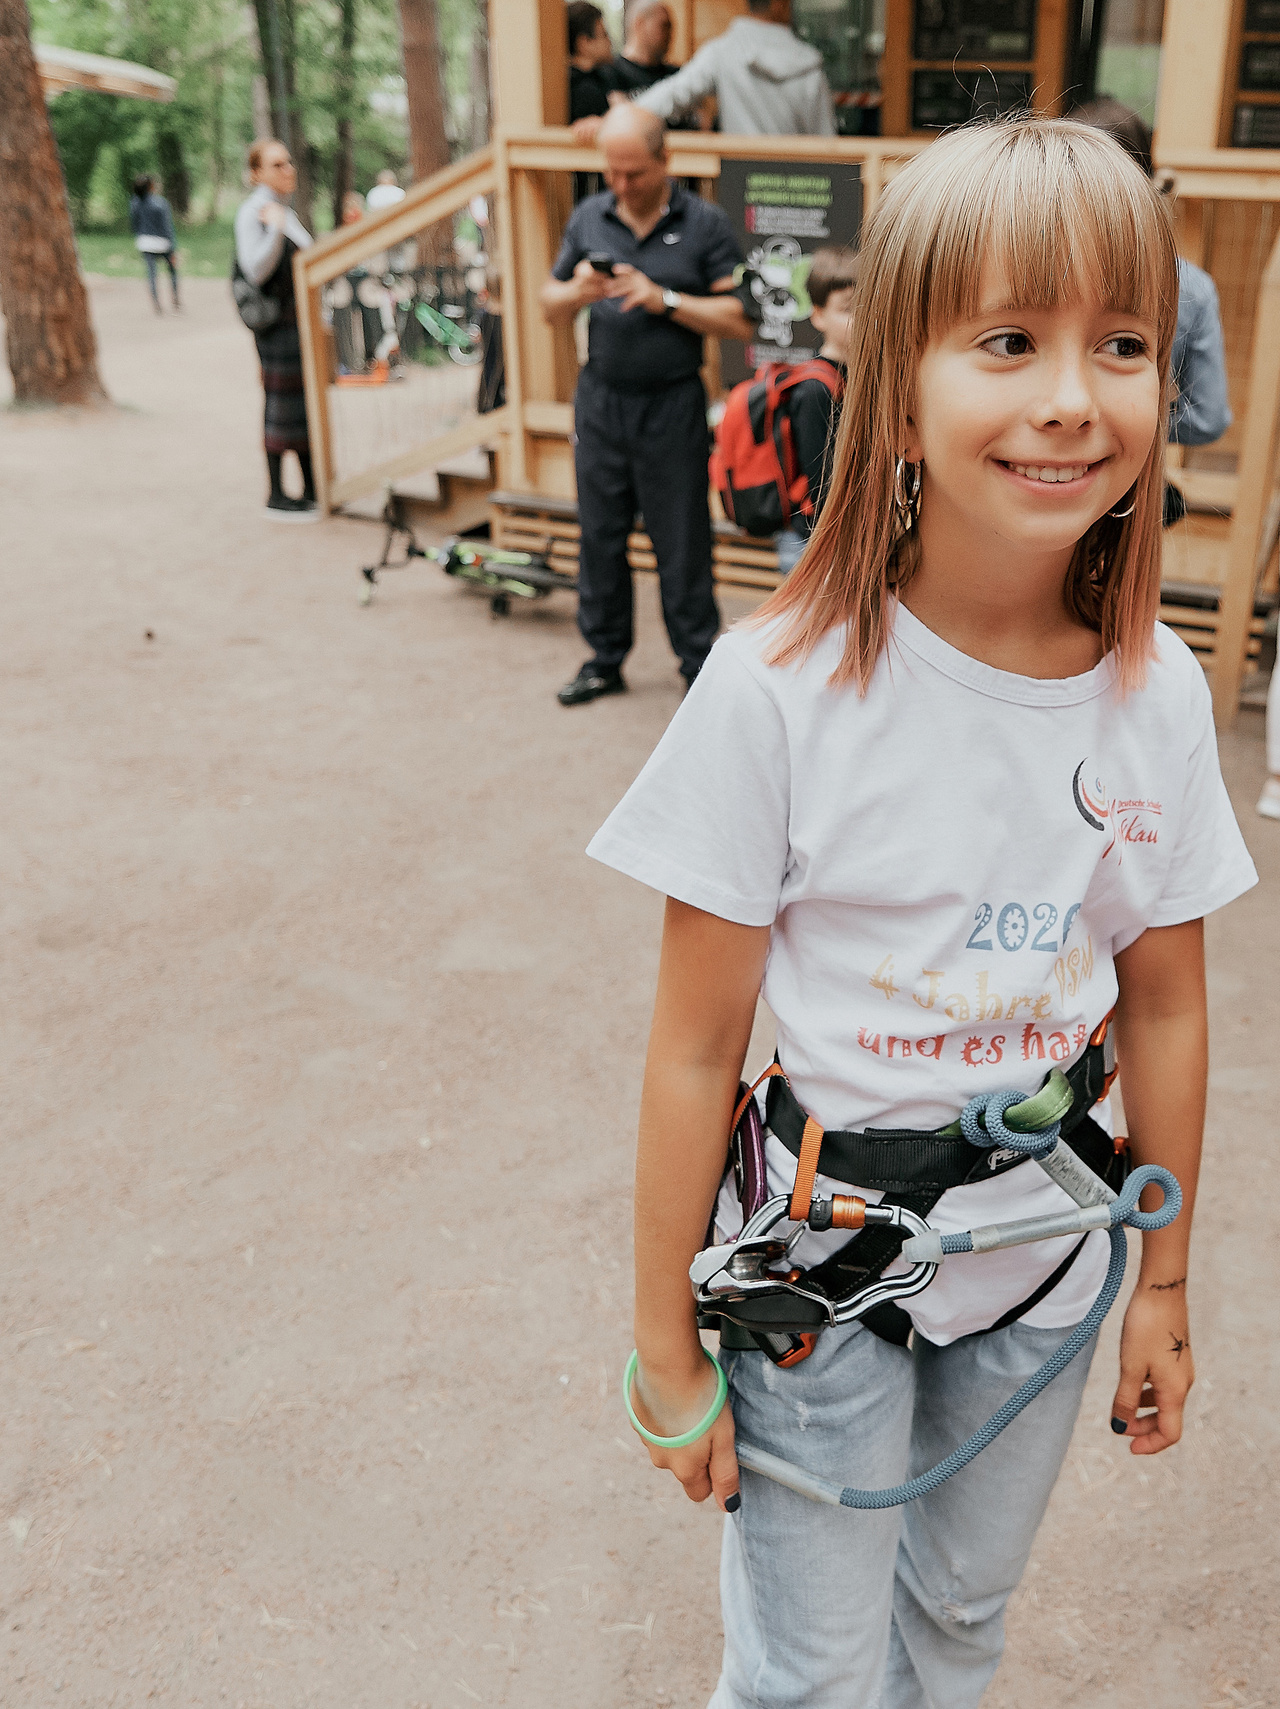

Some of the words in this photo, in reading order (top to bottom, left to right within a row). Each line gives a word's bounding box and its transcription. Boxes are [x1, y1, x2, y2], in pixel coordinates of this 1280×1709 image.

[868, 953, 901, 1001] 4
[912, 967, 1053, 1023] Jahre
[857, 1026, 947, 1060] und
[960, 1034, 1006, 1068] es
